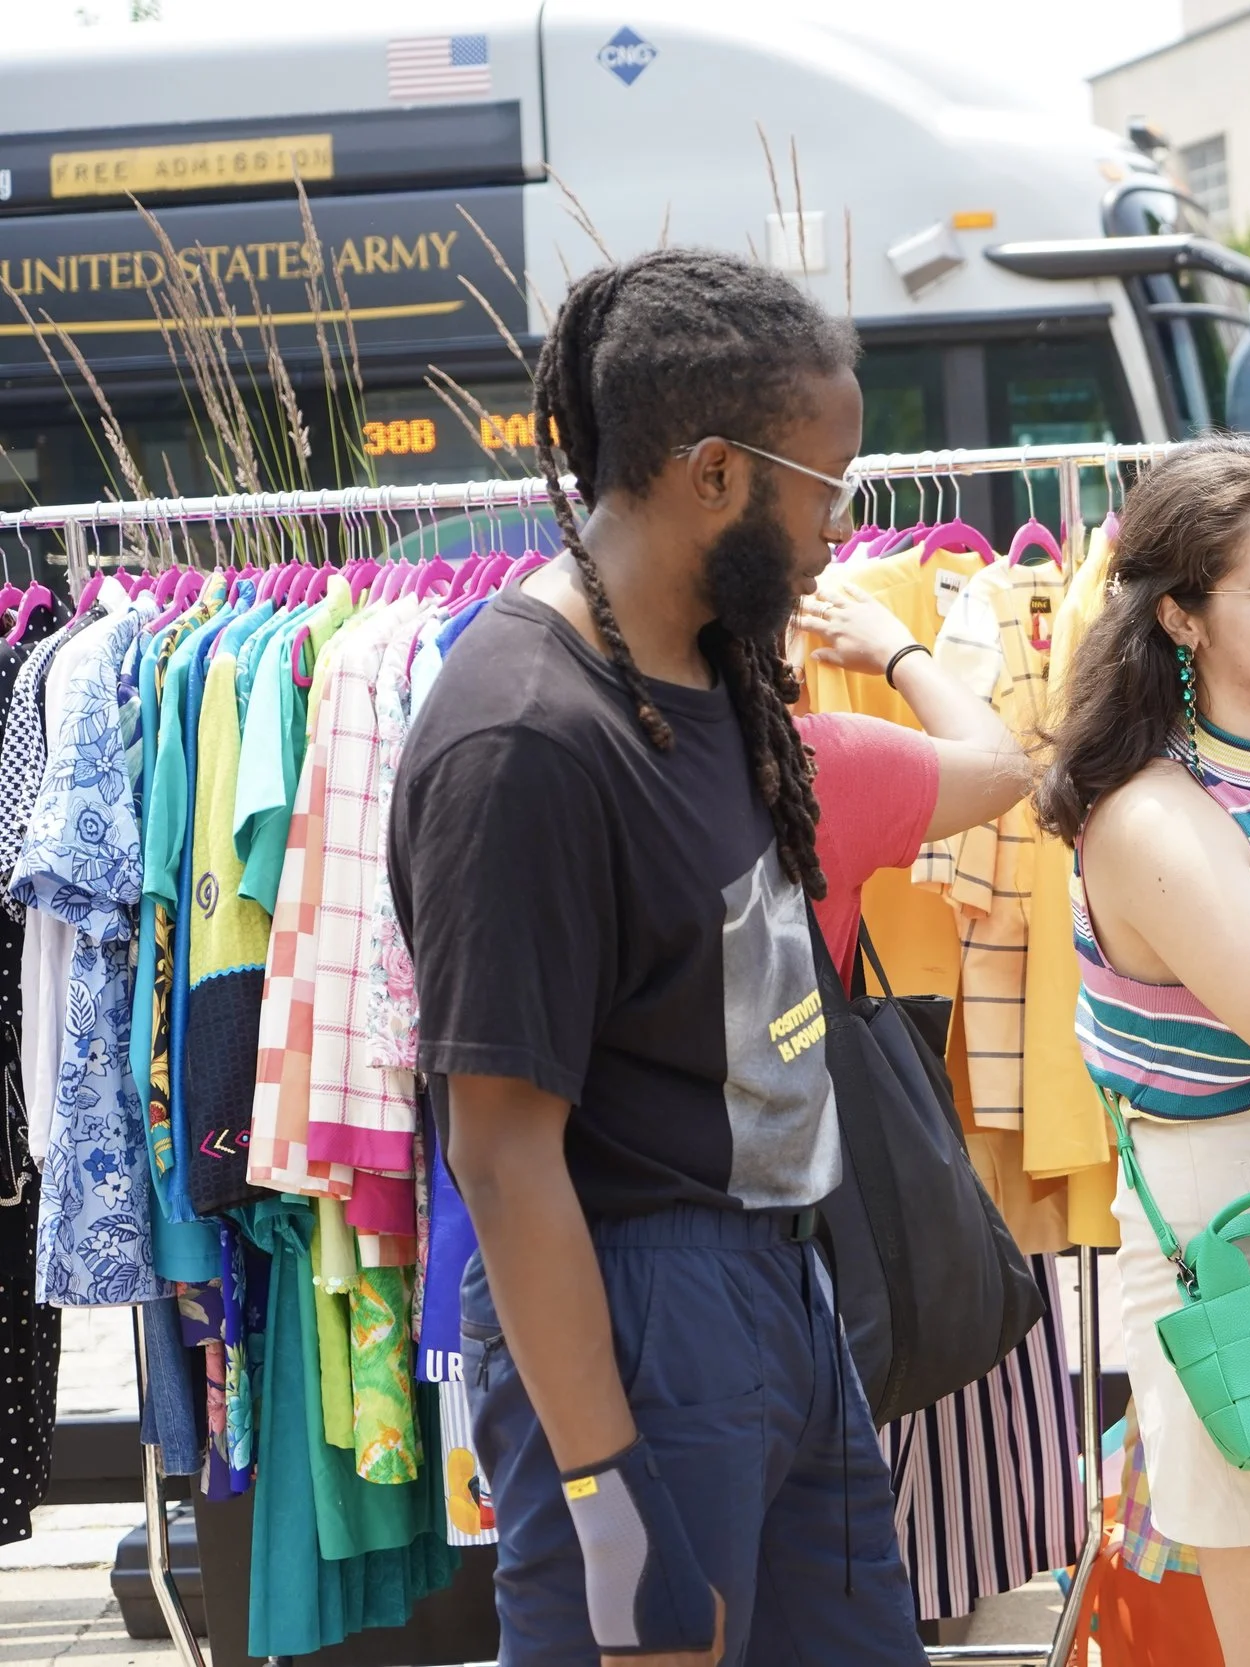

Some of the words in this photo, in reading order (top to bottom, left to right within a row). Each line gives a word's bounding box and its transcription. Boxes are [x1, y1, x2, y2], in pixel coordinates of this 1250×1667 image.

[600, 42, 657, 67] CNG
[56, 160, 129, 184] FREE
[0, 249, 166, 295] UNITED
[176, 239, 324, 286] STATES
[335, 230, 459, 275] ARMY
[778, 1041, 795, 1063] IS
